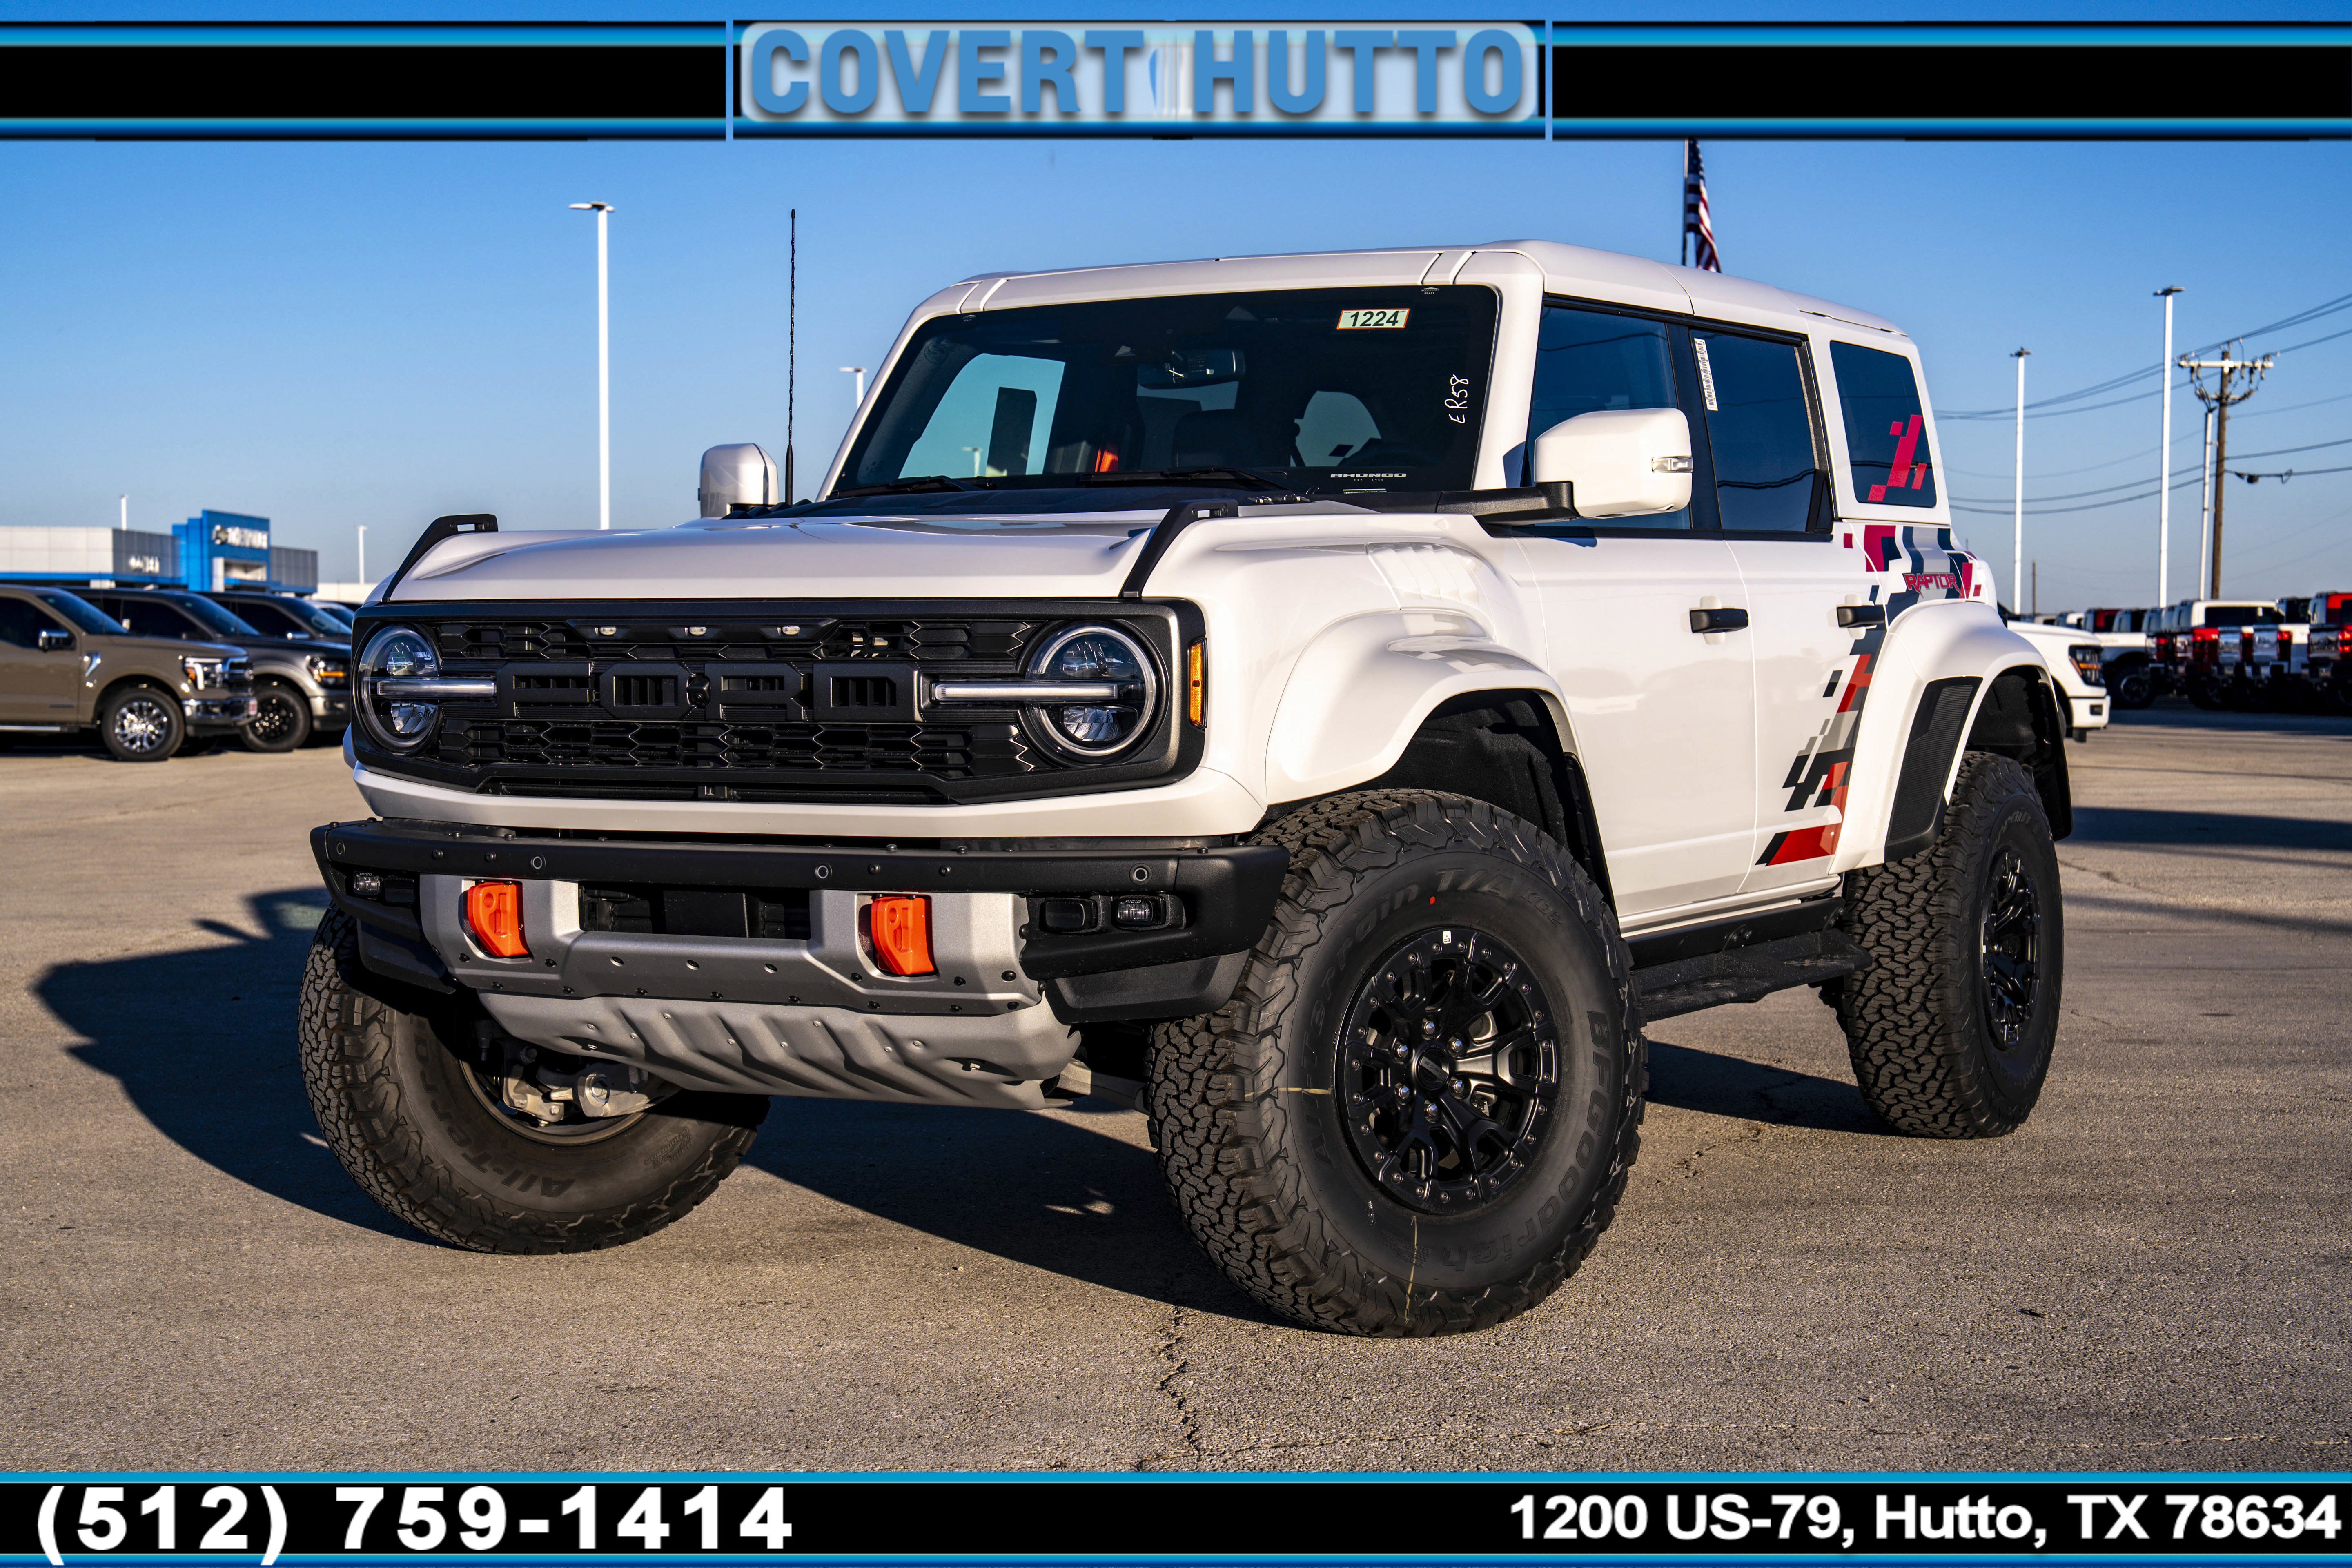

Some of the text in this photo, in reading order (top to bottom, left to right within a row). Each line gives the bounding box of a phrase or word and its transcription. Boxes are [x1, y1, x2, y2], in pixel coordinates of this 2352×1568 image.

[1350, 310, 1399, 327] 1224
[1902, 572, 1963, 599] RAPTOR
[497, 661, 922, 722] FORD
[1424, 1060, 1444, 1077] FORD
[1441, 1010, 1613, 1271] BFGoodrich
